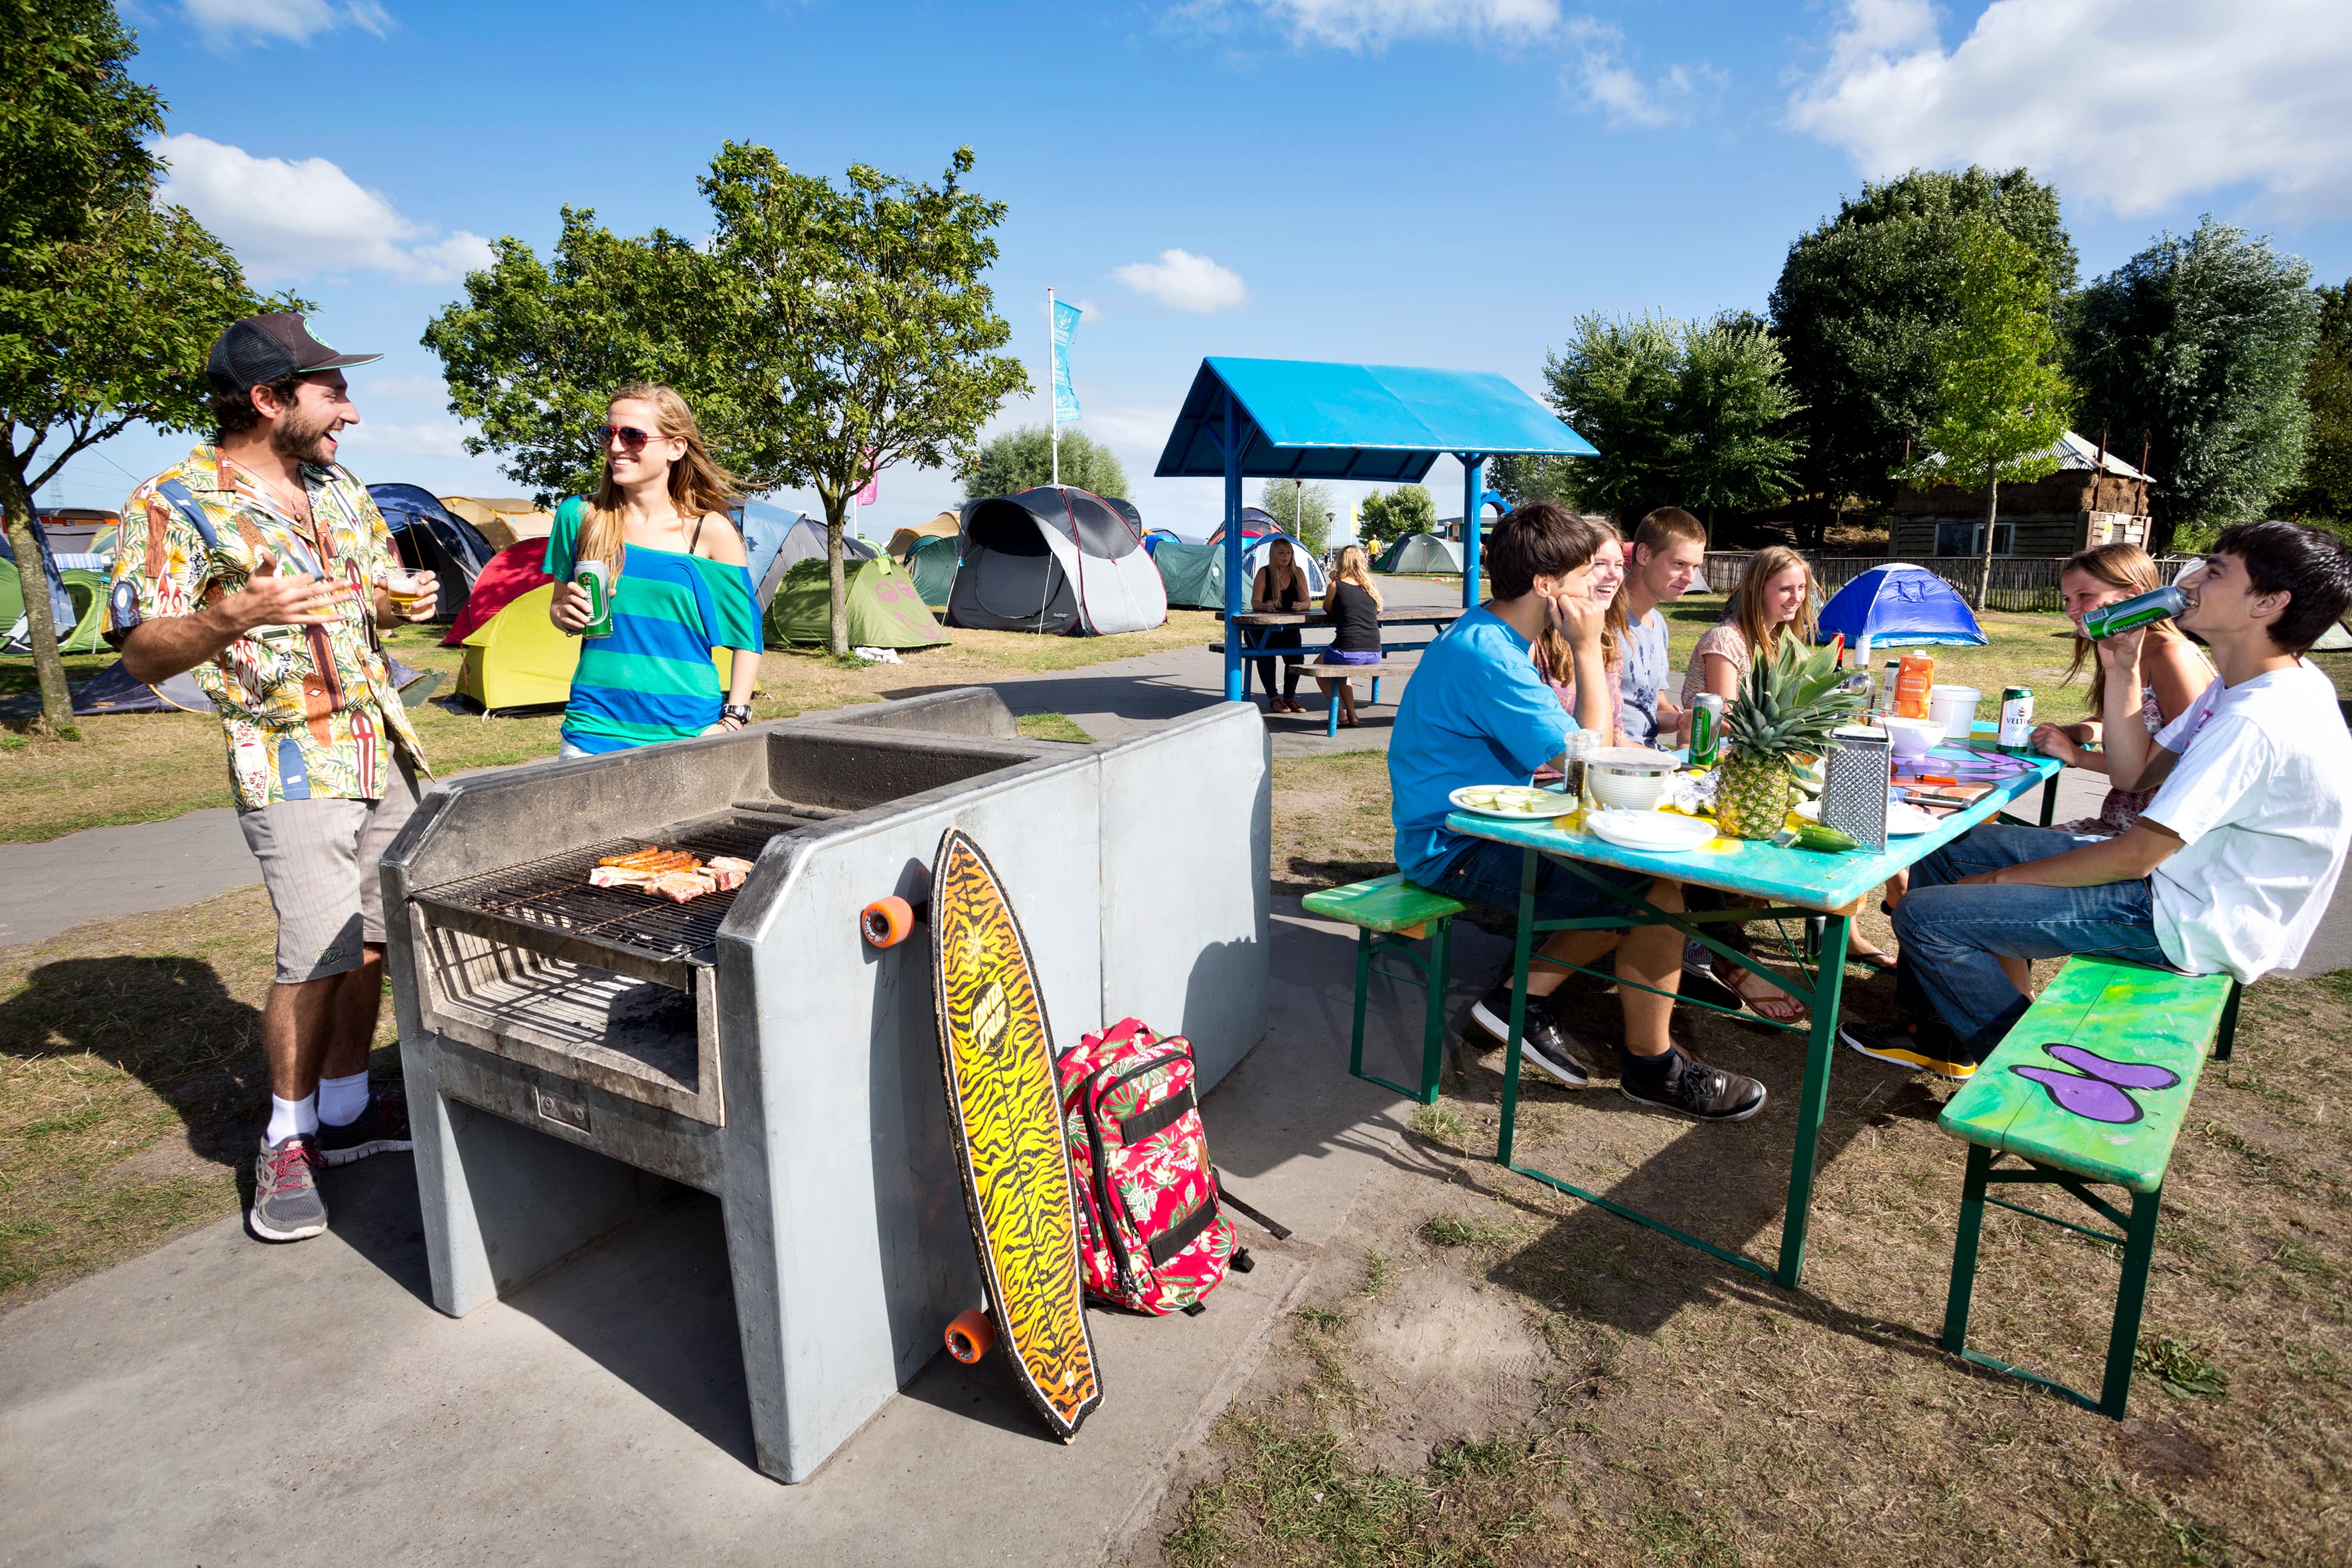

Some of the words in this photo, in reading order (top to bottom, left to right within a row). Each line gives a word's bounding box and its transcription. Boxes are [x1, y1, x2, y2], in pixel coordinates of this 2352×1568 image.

[2112, 617, 2155, 634] Heineken
[971, 980, 1005, 1038] SANTA
[979, 1000, 1007, 1051] CRUZ
